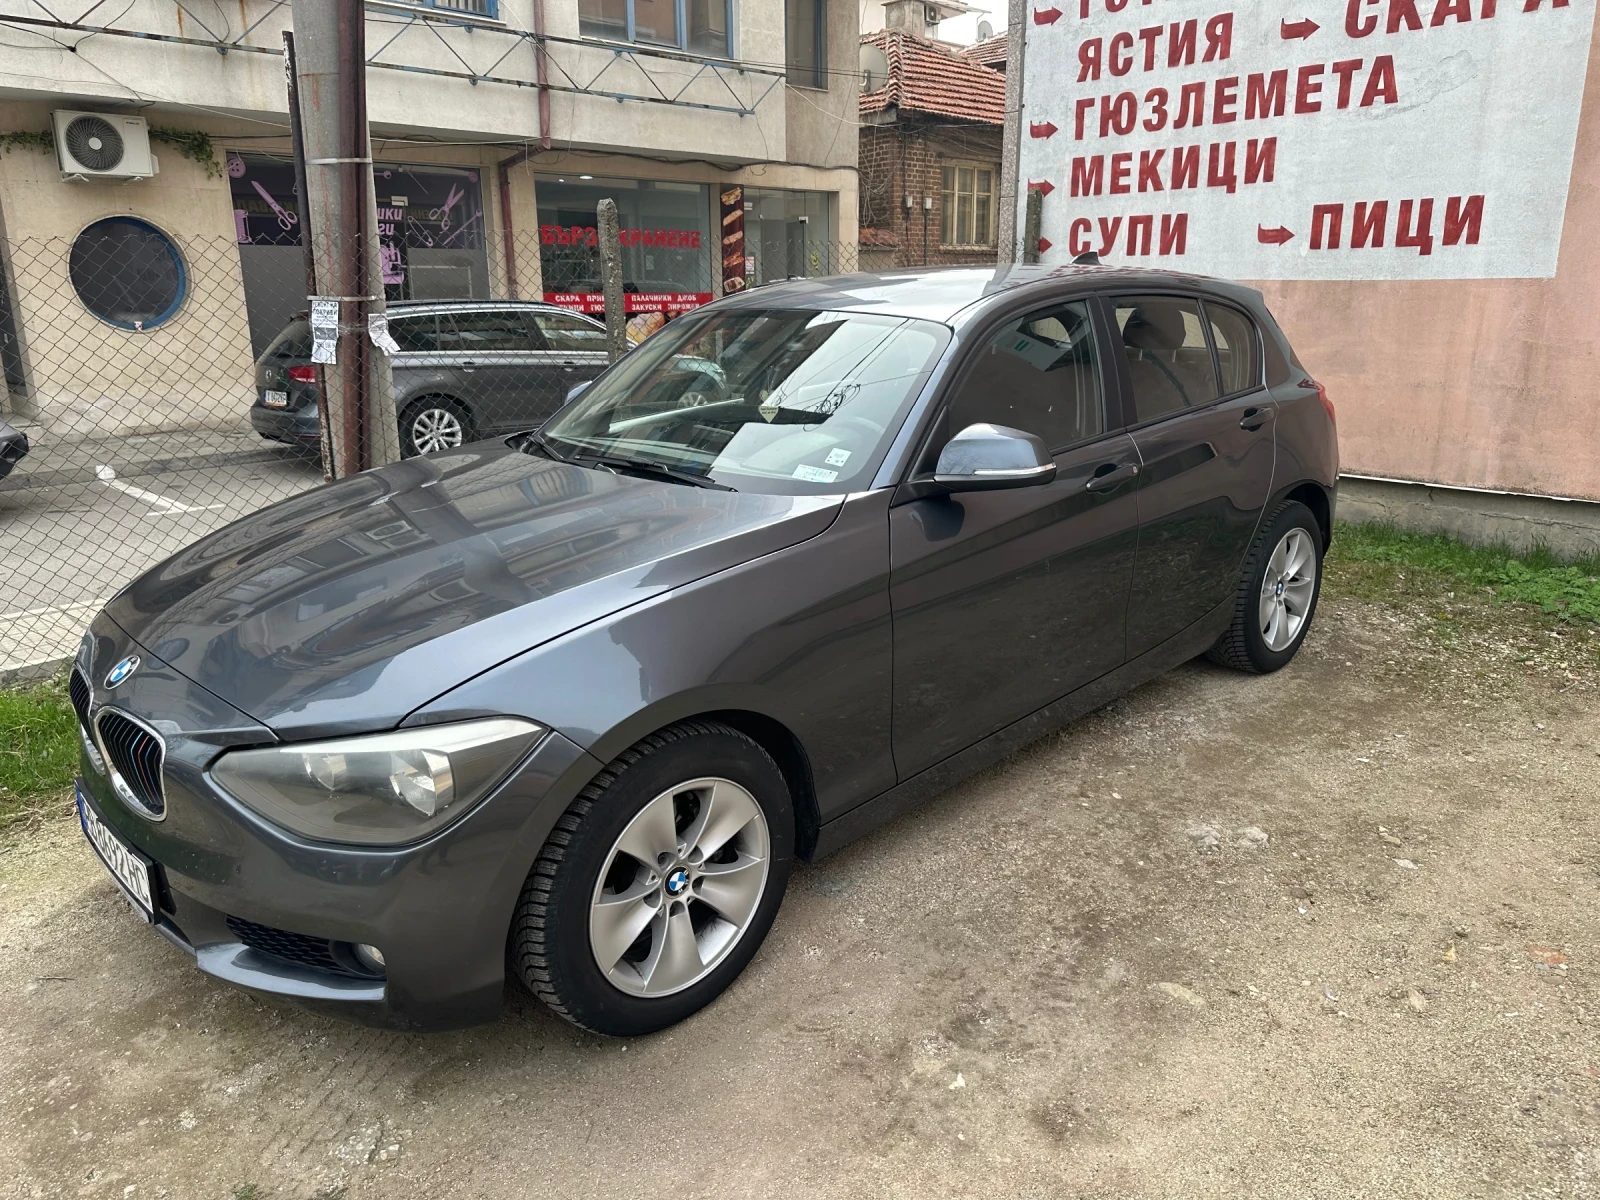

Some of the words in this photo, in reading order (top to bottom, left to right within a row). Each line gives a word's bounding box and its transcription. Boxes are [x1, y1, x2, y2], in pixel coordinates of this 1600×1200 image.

[1077, 12, 1234, 82] ЯСТИЯ
[1074, 55, 1399, 141] ГЮЗЛЕМЕТА
[1069, 136, 1278, 197] МЕКИЦИ
[541, 225, 599, 246] БЪРЗ
[1068, 213, 1188, 258] СУПИ
[1309, 194, 1485, 256] ПИЦИ
[555, 294, 581, 302] СКАРА
[631, 304, 662, 312] ЗАКУСКИ
